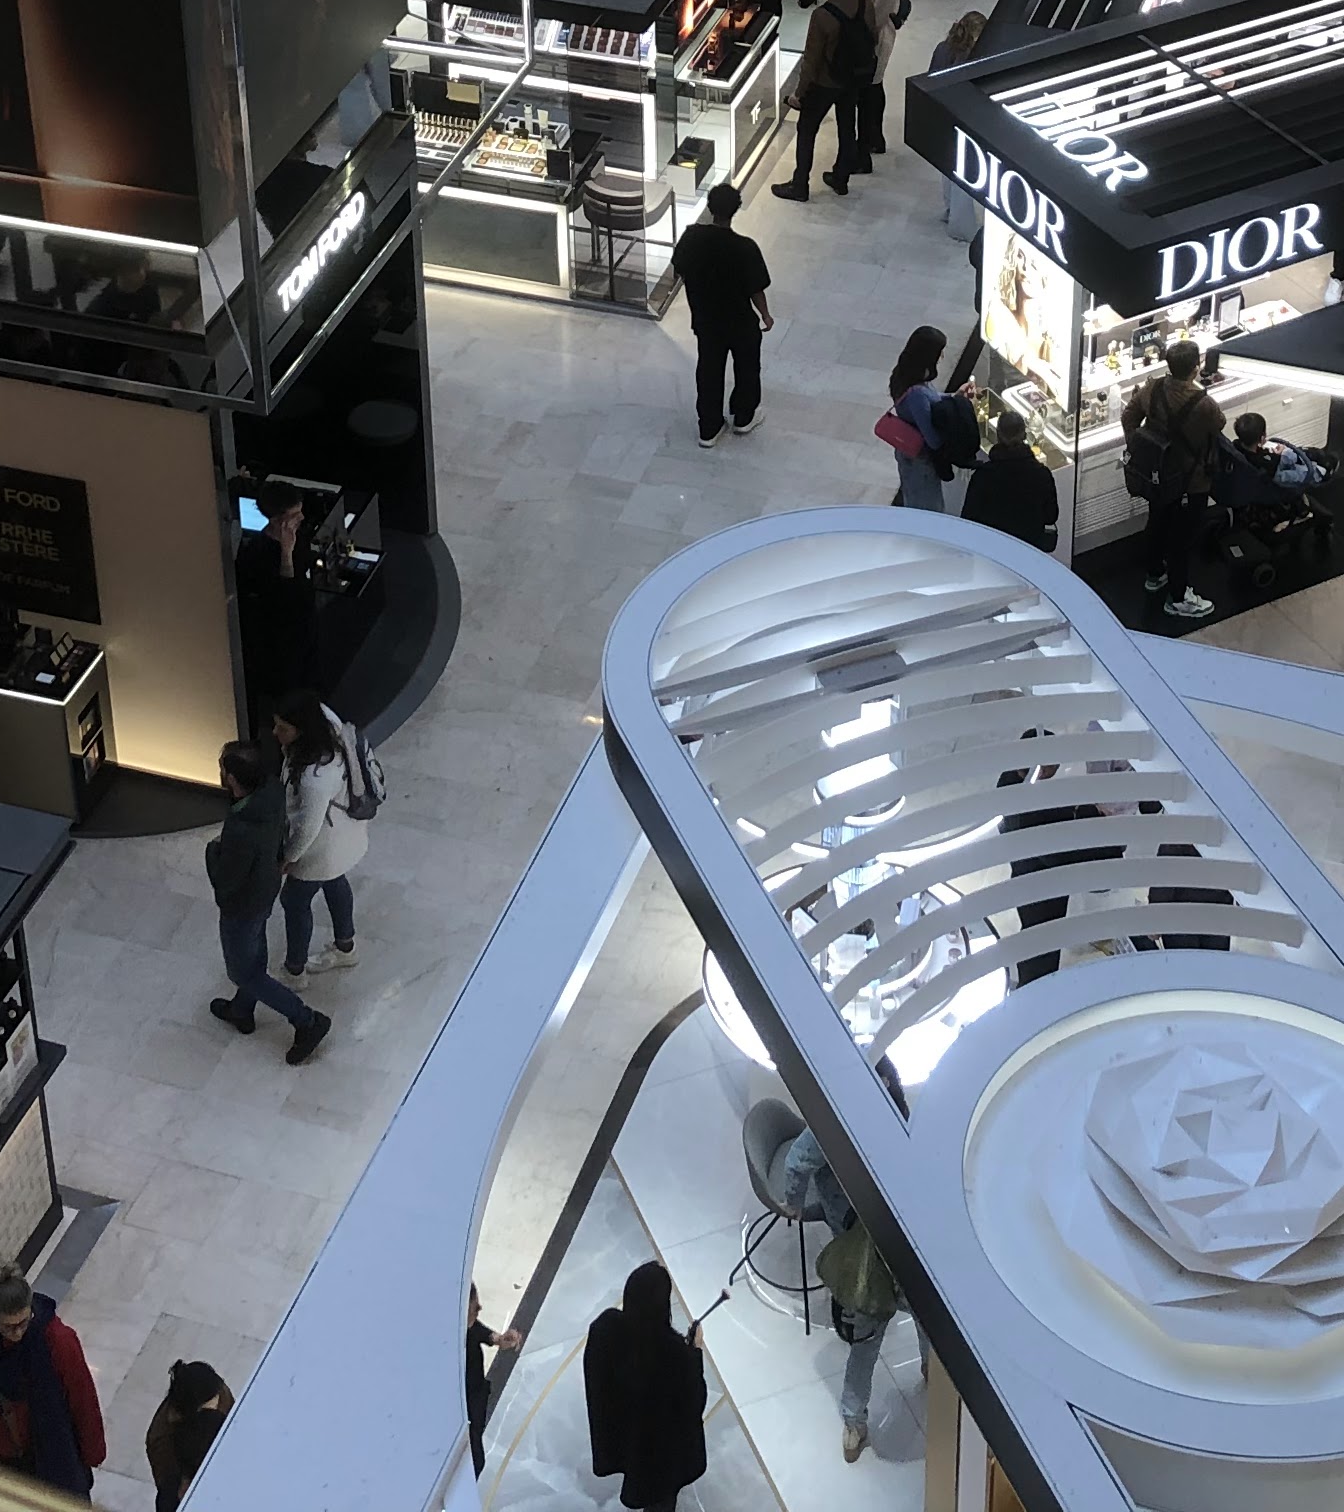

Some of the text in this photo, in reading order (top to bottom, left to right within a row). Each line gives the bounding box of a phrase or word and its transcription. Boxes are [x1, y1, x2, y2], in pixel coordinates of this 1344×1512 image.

[1001, 91, 1151, 193] DIOR
[952, 123, 1069, 266] DIOR
[277, 191, 365, 314] TOM FORD
[1155, 201, 1325, 300] DIOR
[1139, 330, 1161, 344] DIOR
[4, 488, 61, 512] FORD
